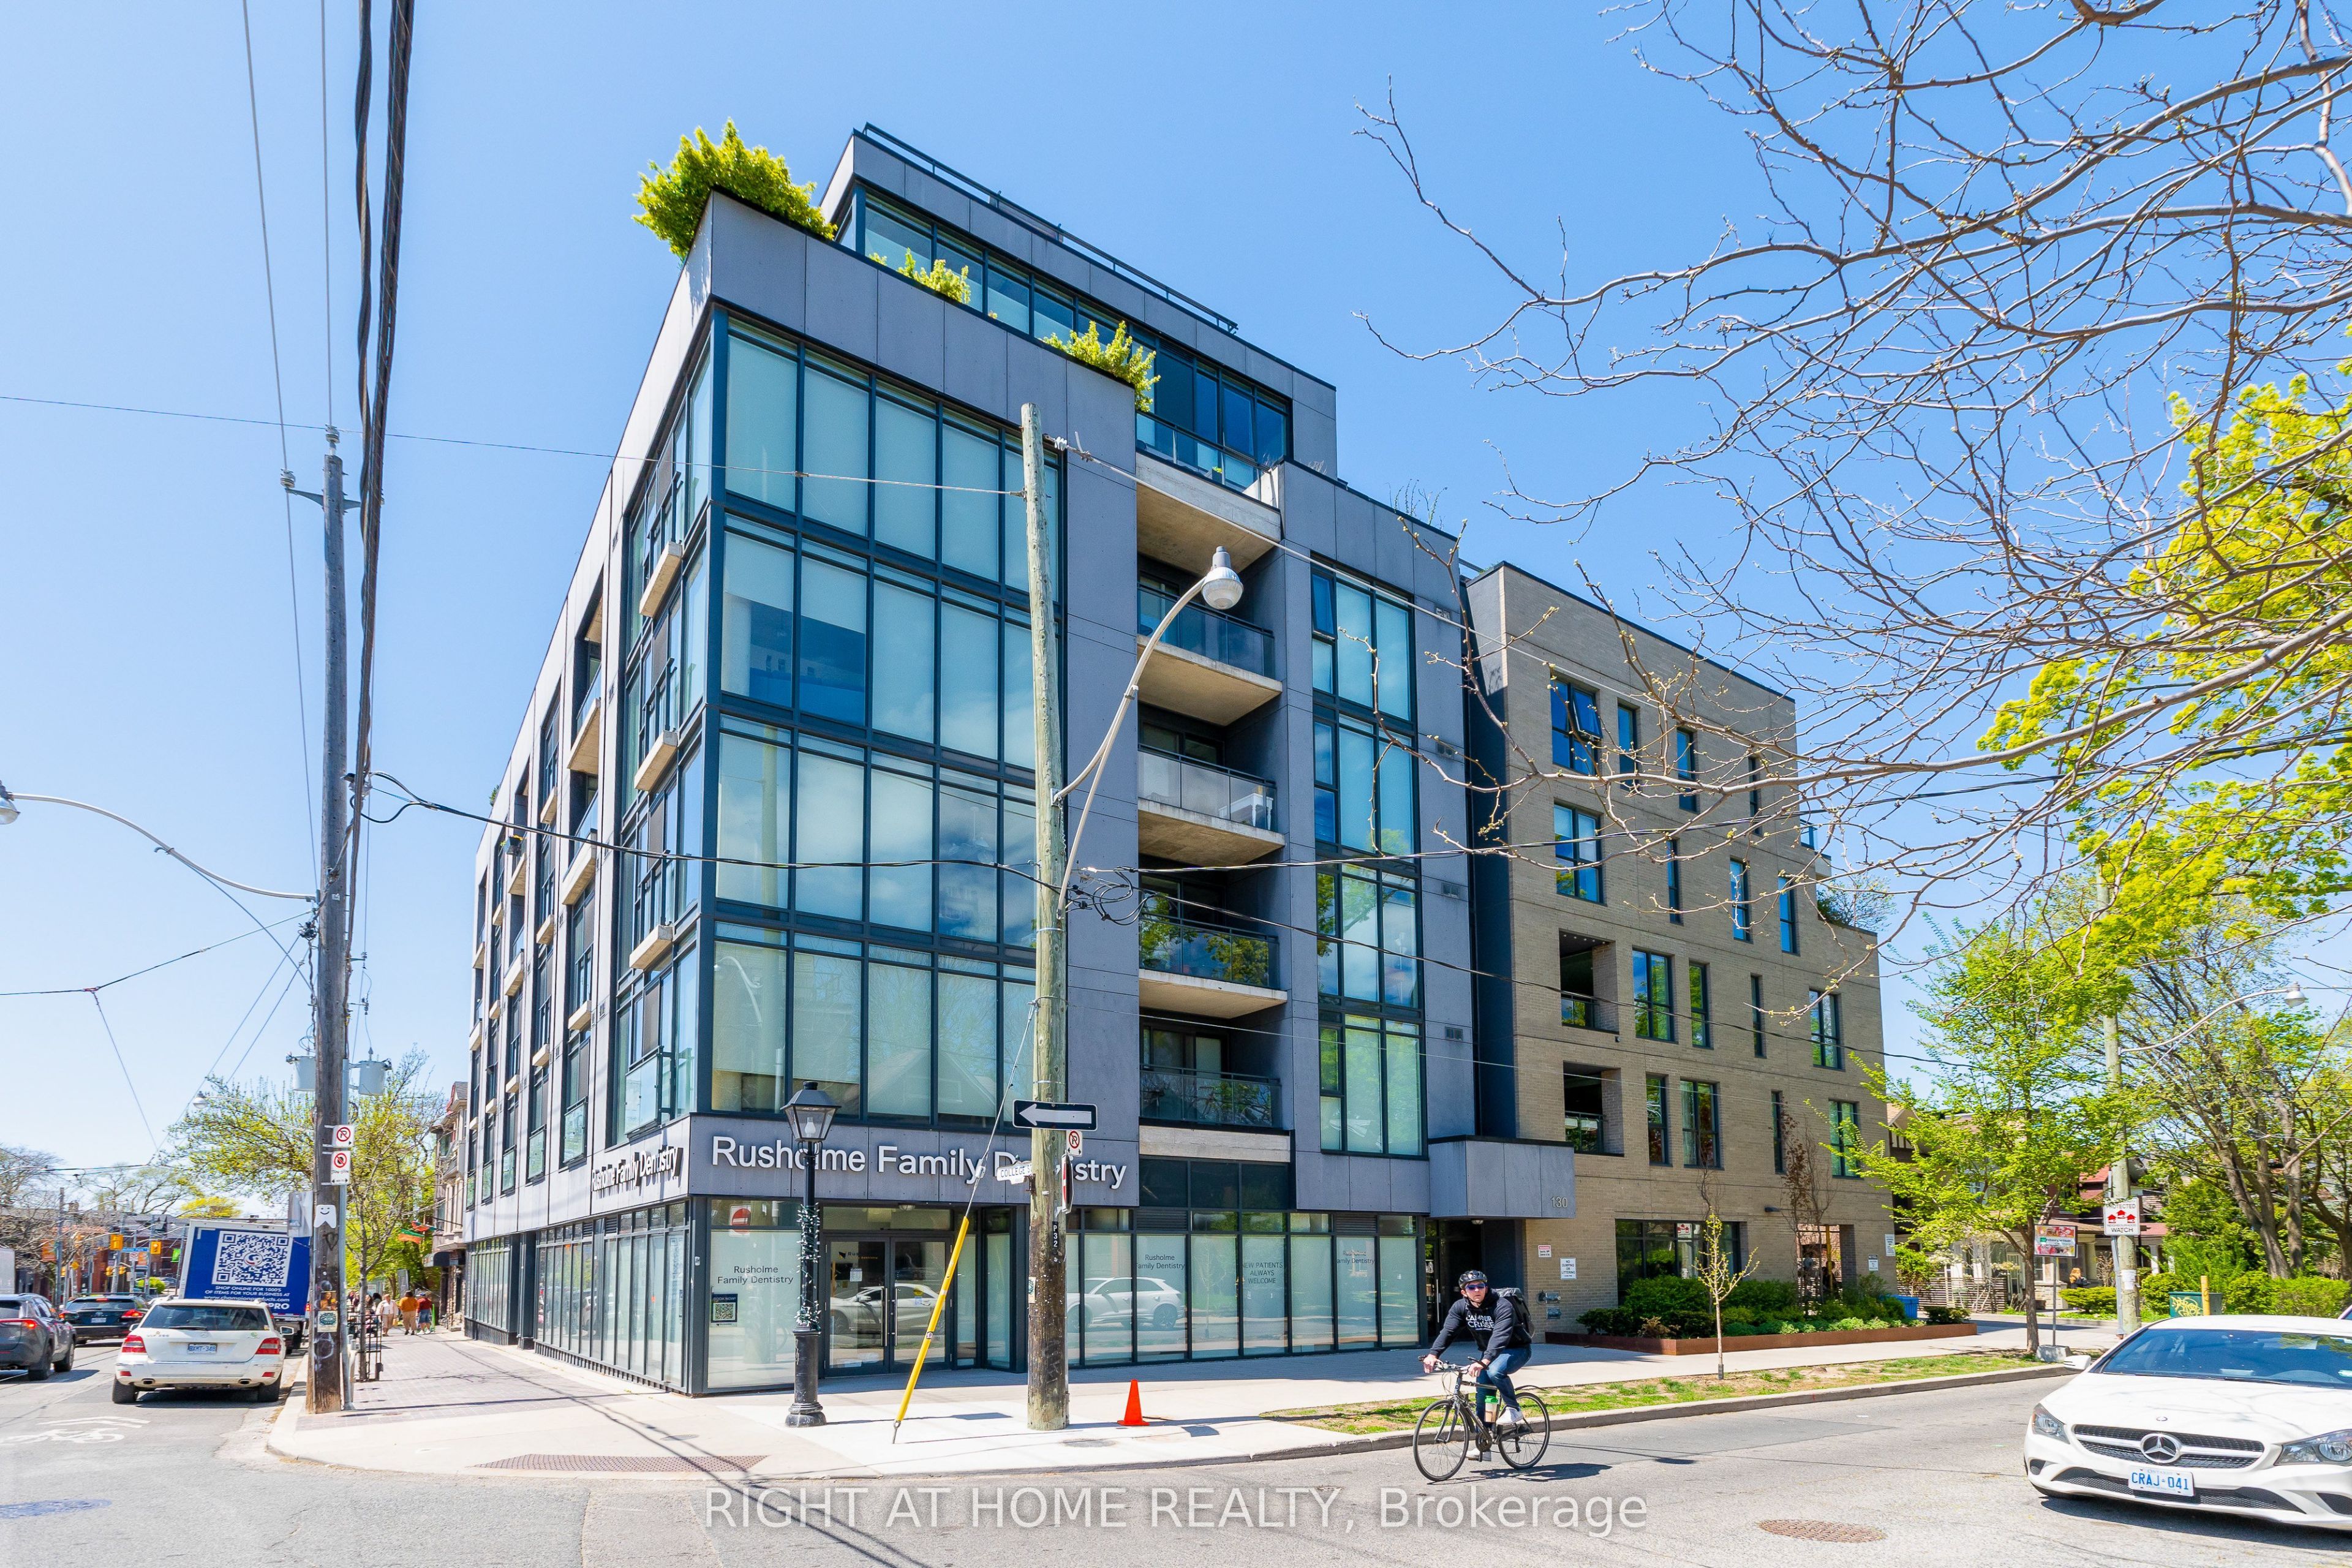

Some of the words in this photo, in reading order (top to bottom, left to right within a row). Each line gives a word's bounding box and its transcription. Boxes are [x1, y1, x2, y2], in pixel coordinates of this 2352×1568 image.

[616, 1155, 639, 1187] Family
[639, 1145, 678, 1178] Dentistry
[712, 1136, 865, 1172] Rusholme
[878, 1145, 982, 1185] Family
[995, 1151, 1127, 1189] Dstry
[1000, 1166, 1025, 1178] COLLEGE
[1551, 1196, 1568, 1208] 130
[717, 1276, 748, 1285] Family
[751, 1276, 794, 1284] Dentistry
